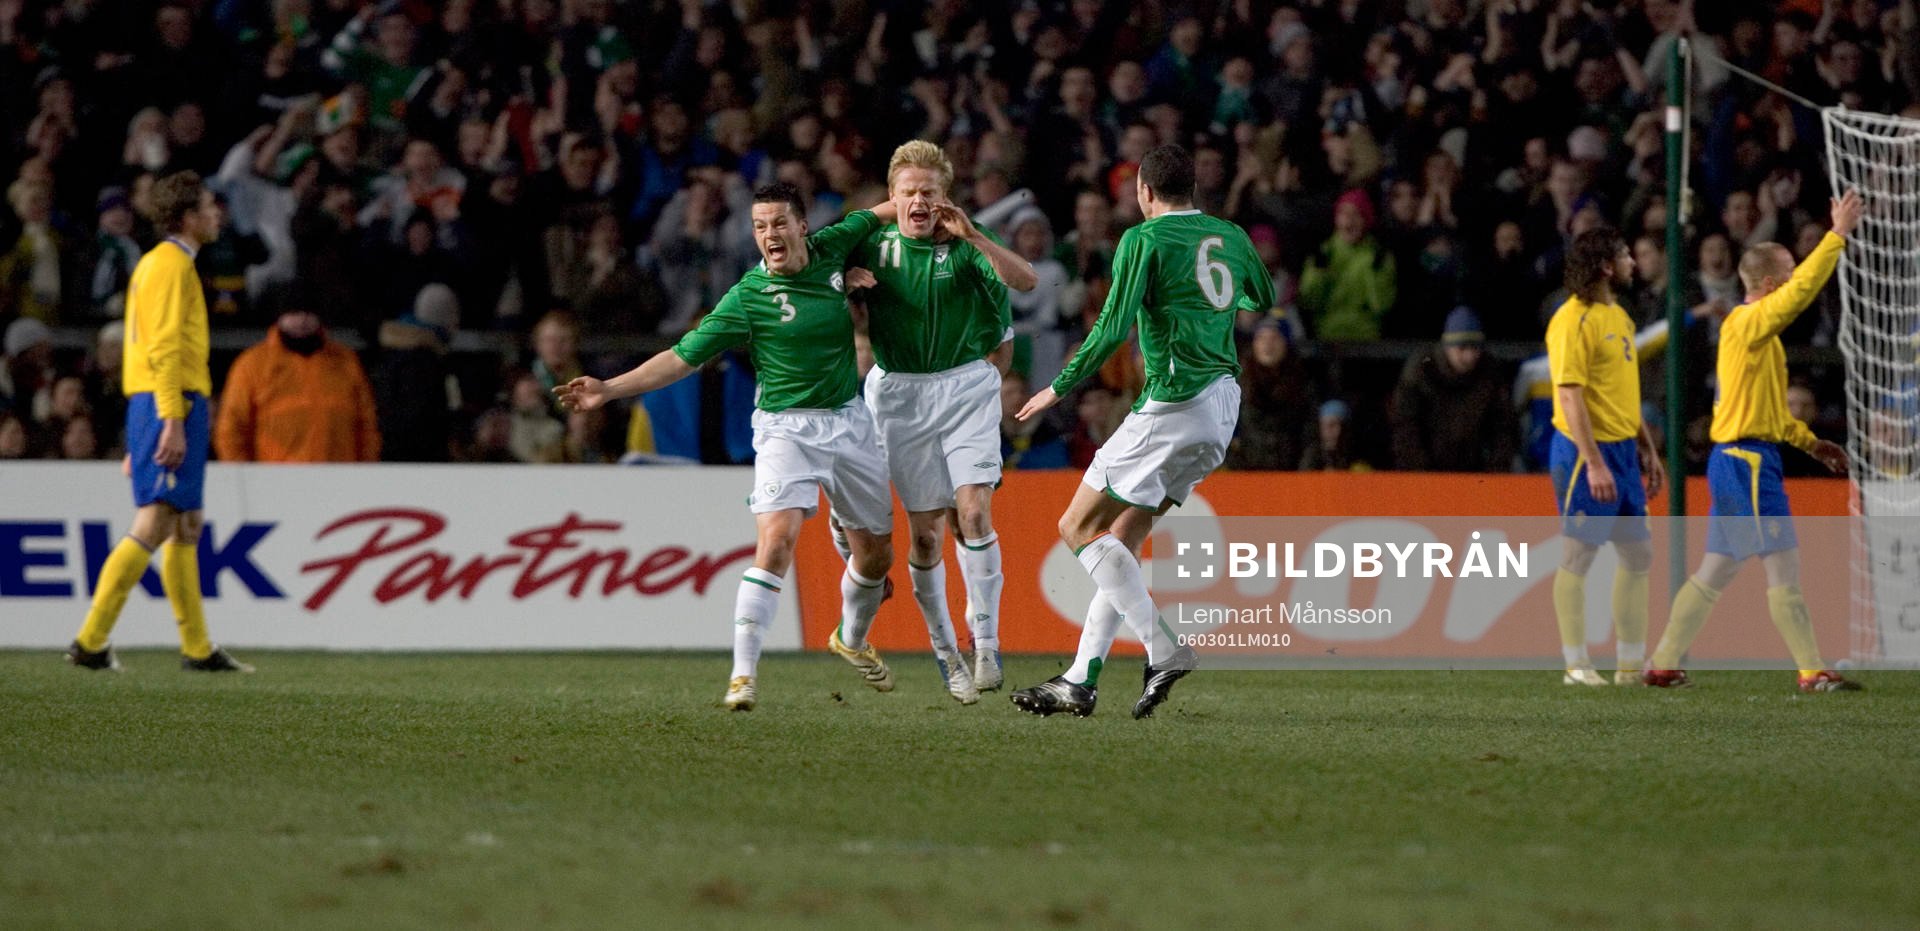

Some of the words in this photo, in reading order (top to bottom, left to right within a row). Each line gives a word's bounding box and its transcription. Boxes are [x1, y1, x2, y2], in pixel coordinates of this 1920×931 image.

[878, 238, 900, 268] 11
[1197, 237, 1233, 309] 6
[772, 292, 796, 322] 3
[301, 507, 757, 612] Partner
